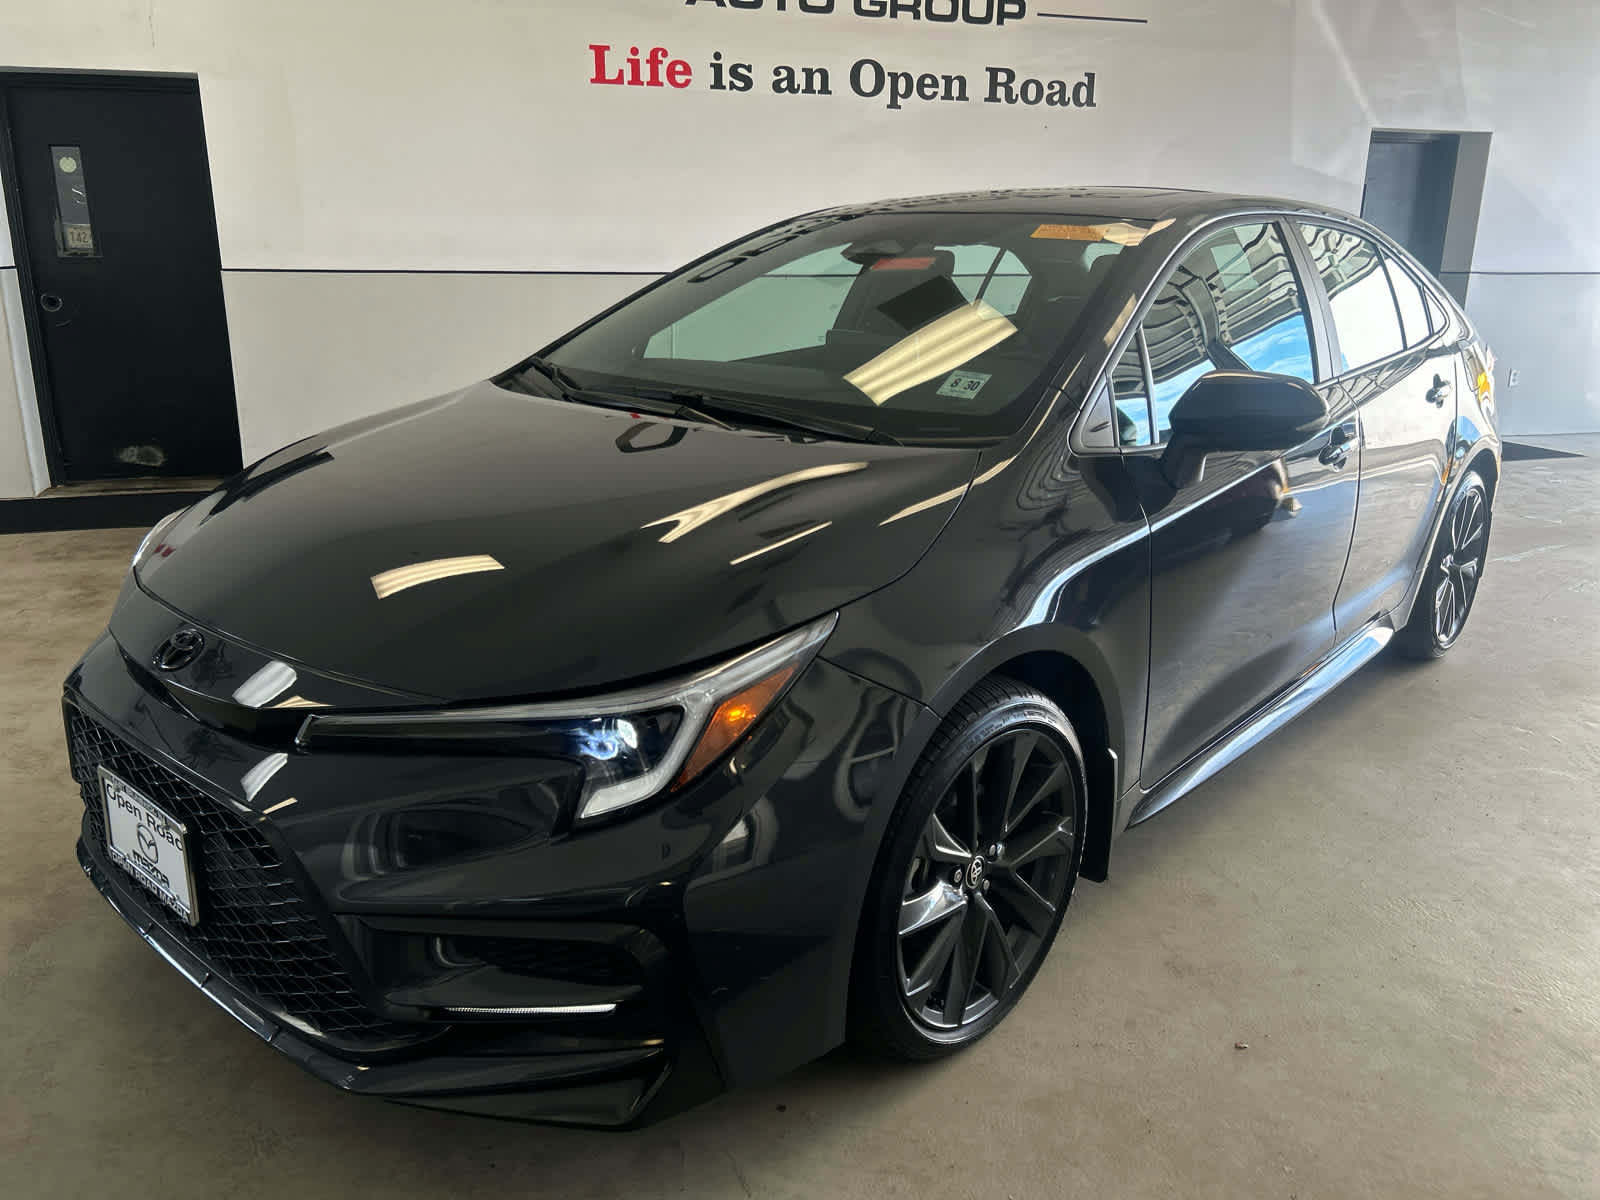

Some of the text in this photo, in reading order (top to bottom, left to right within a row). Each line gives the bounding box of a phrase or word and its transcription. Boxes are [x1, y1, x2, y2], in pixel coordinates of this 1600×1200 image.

[853, 0, 1026, 25] GROUP
[589, 44, 1097, 109] Life is an Open Road
[107, 785, 142, 821] Open
